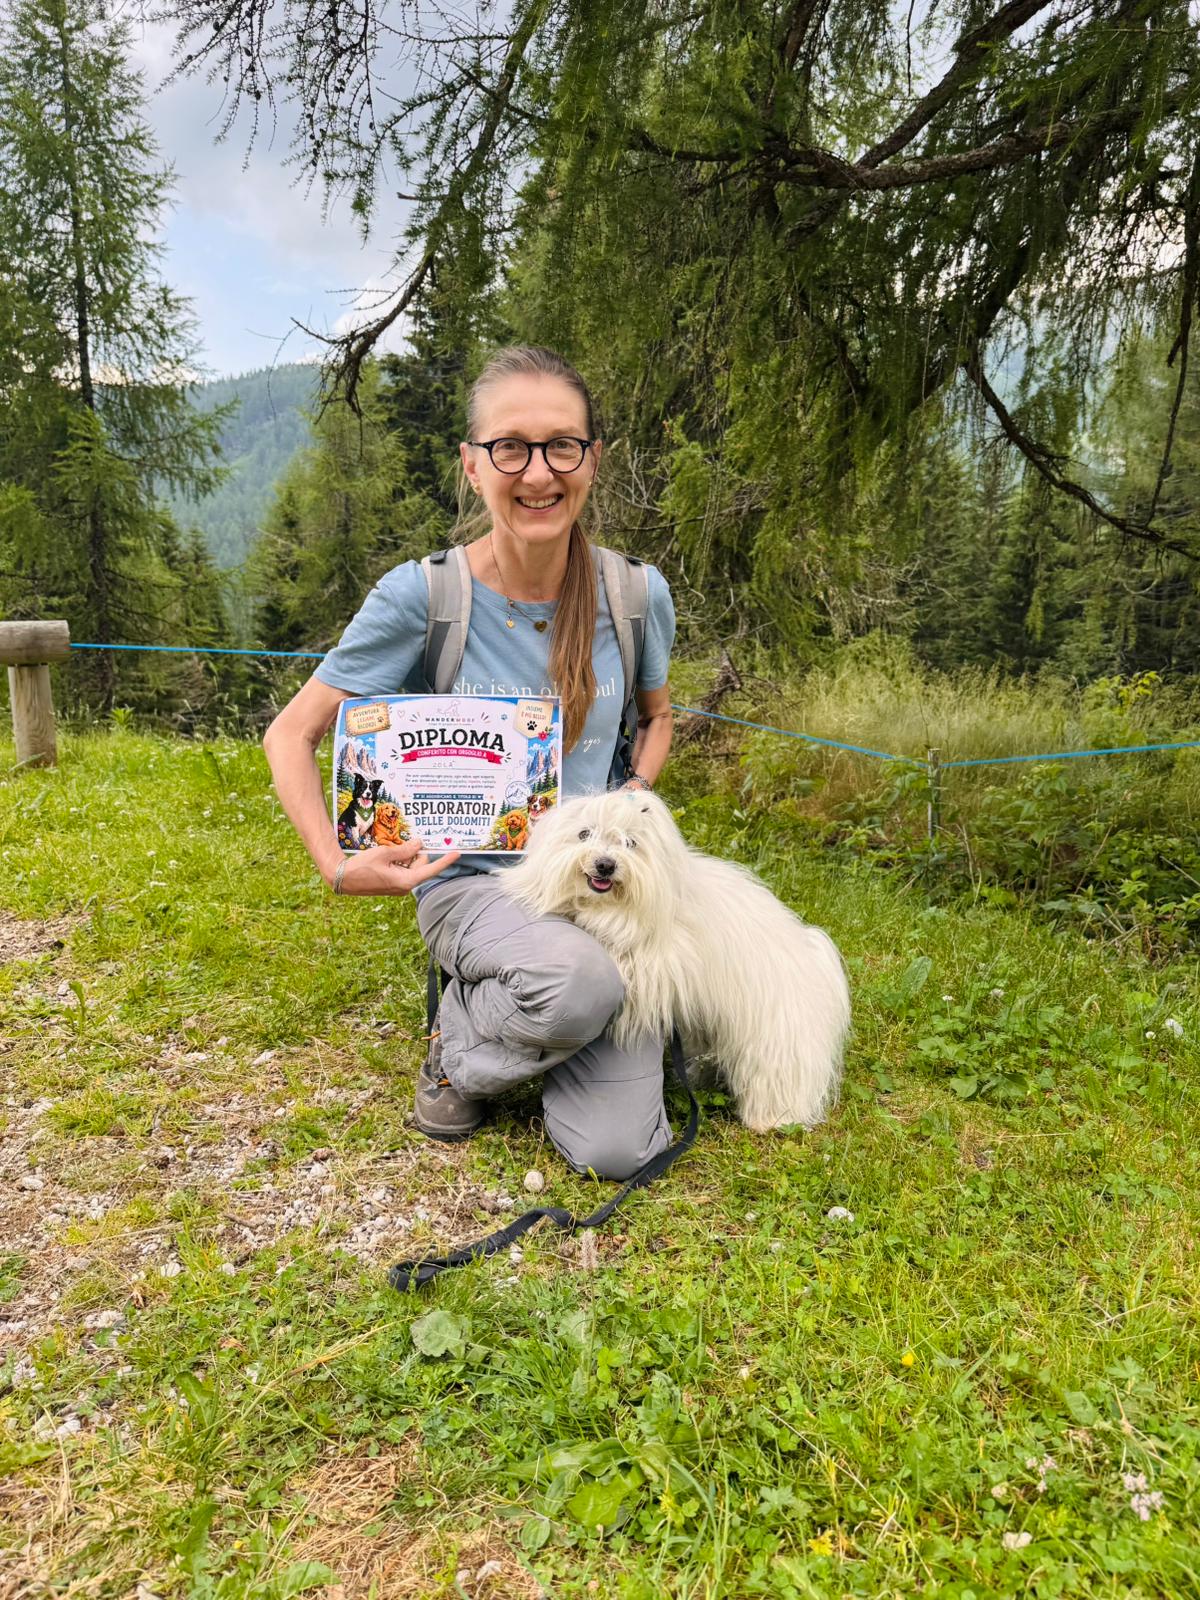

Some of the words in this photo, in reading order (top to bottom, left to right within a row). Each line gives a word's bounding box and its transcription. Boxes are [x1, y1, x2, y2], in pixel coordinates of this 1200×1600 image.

[453, 677, 482, 695] she
[491, 679, 505, 695] is
[512, 685, 532, 696] an
[353, 707, 379, 717] AVVENTURA
[398, 728, 505, 752] DIPLOMA
[417, 748, 446, 757] CONFERITO
[458, 749, 482, 757] ORGOGLIO
[404, 801, 496, 816] ESPLORATORI
[415, 816, 444, 826] DELLE
[447, 816, 491, 826] DOLOMITI
